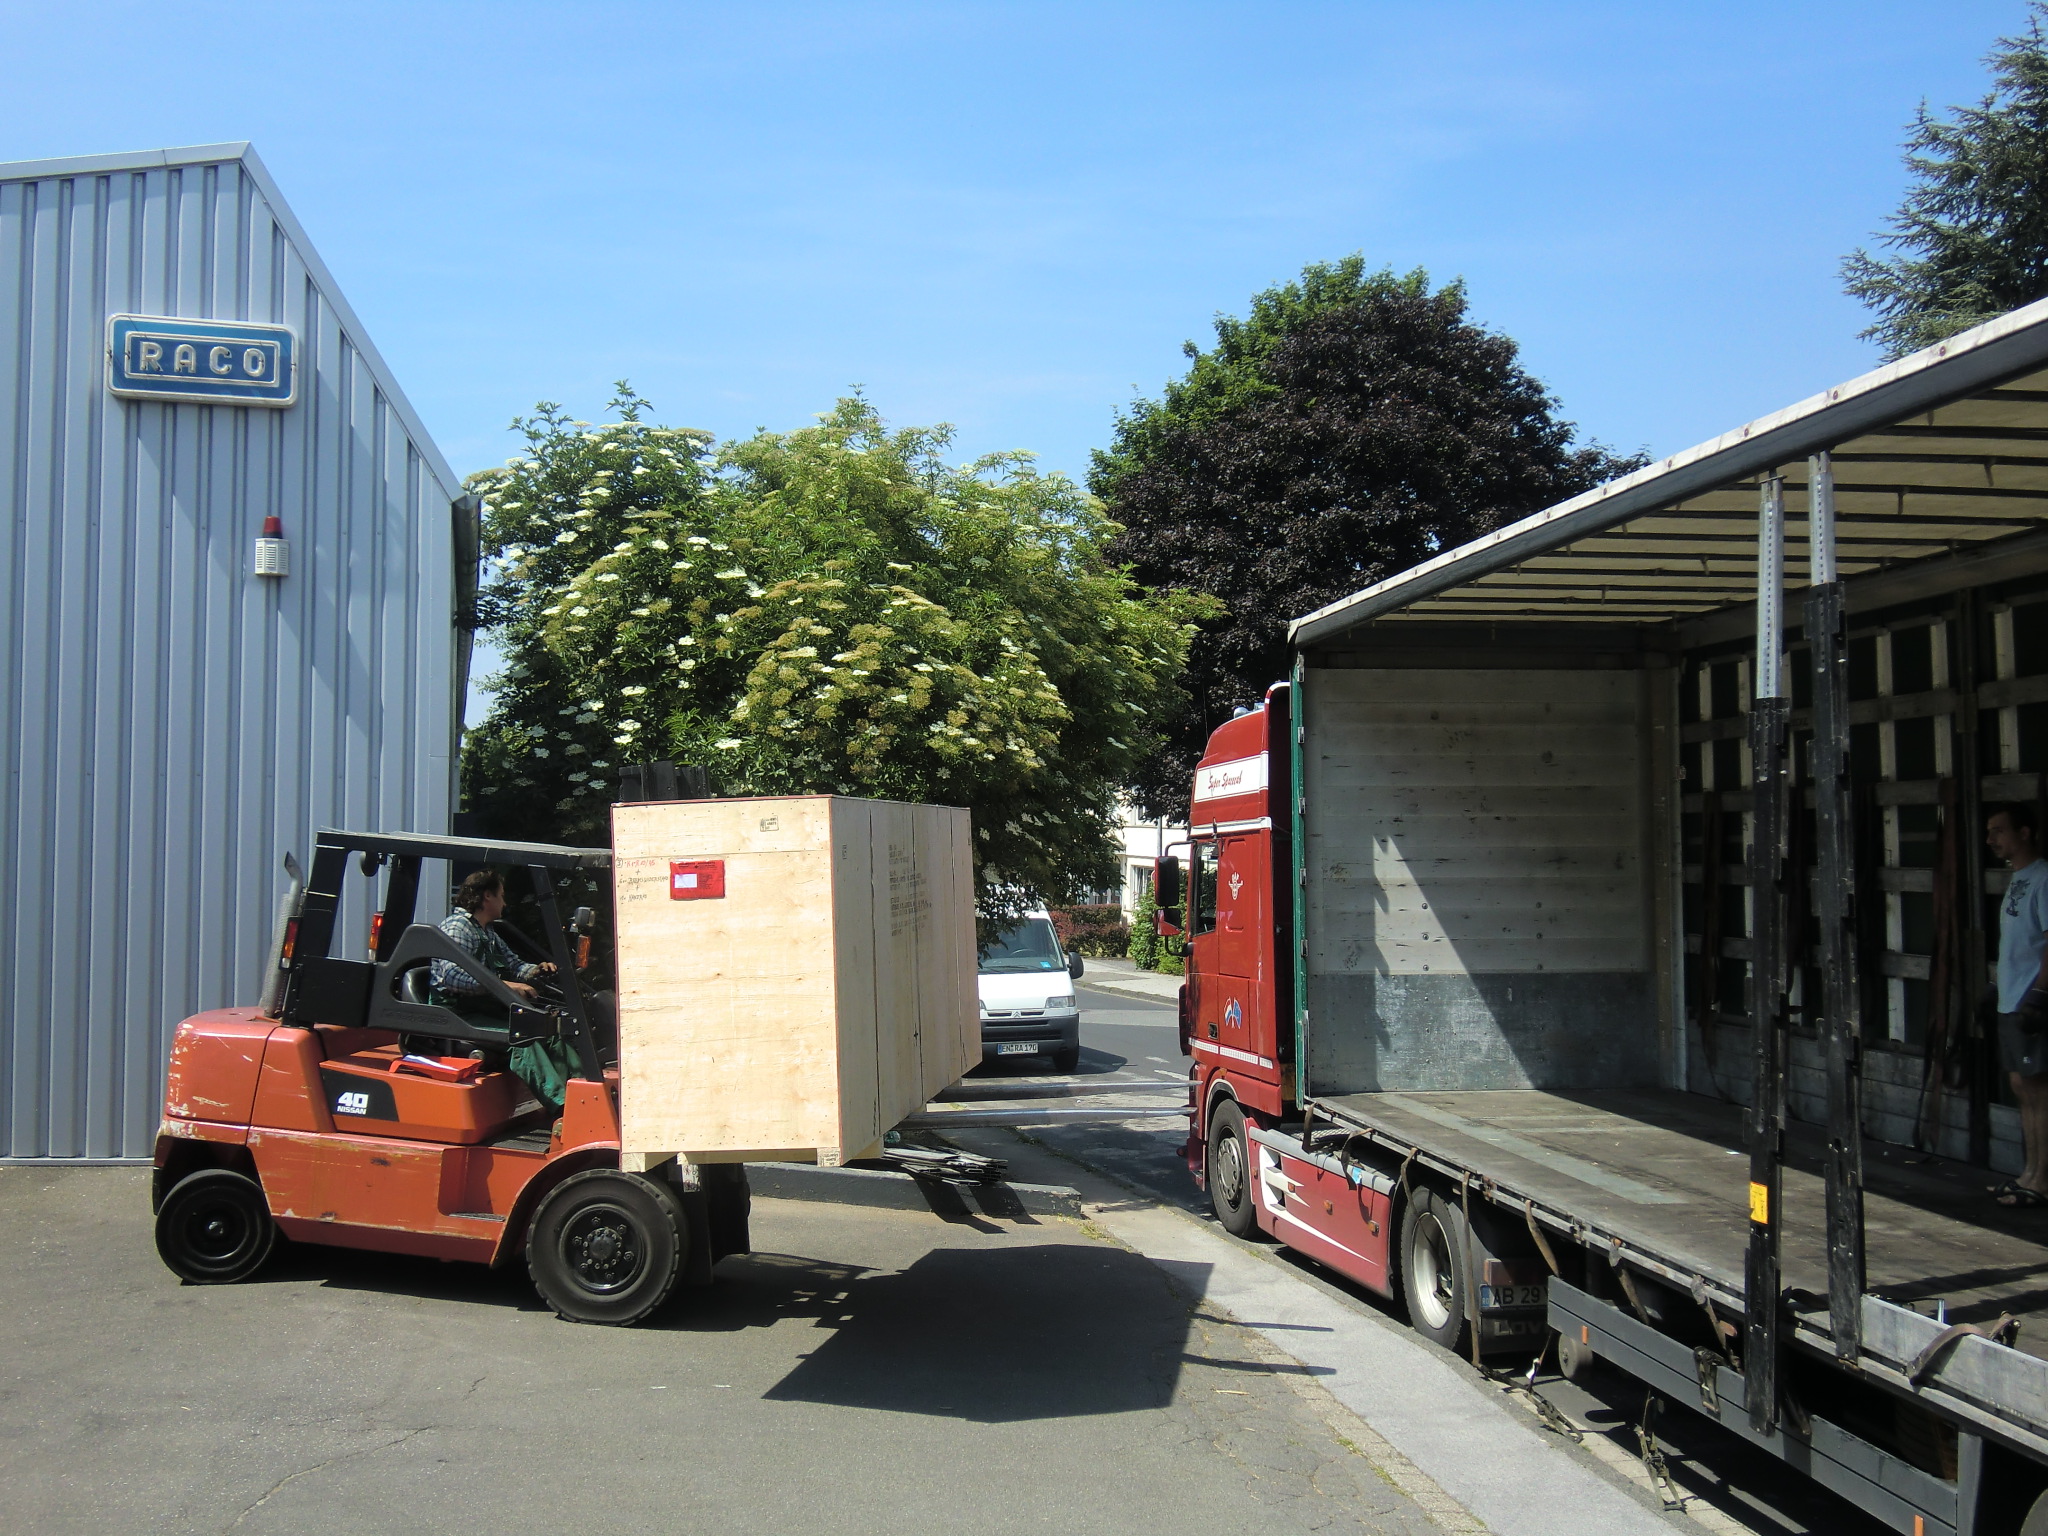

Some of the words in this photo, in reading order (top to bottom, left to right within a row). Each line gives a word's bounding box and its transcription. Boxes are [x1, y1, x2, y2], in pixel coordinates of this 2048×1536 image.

[139, 341, 266, 378] RACO
[1002, 1044, 1011, 1052] EN
[1014, 1044, 1024, 1052] RA
[1024, 1044, 1037, 1052] 170
[338, 1092, 369, 1108] 40
[337, 1105, 367, 1115] NISSAN
[1493, 1287, 1514, 1305] AB
[1521, 1286, 1540, 1304] 29
